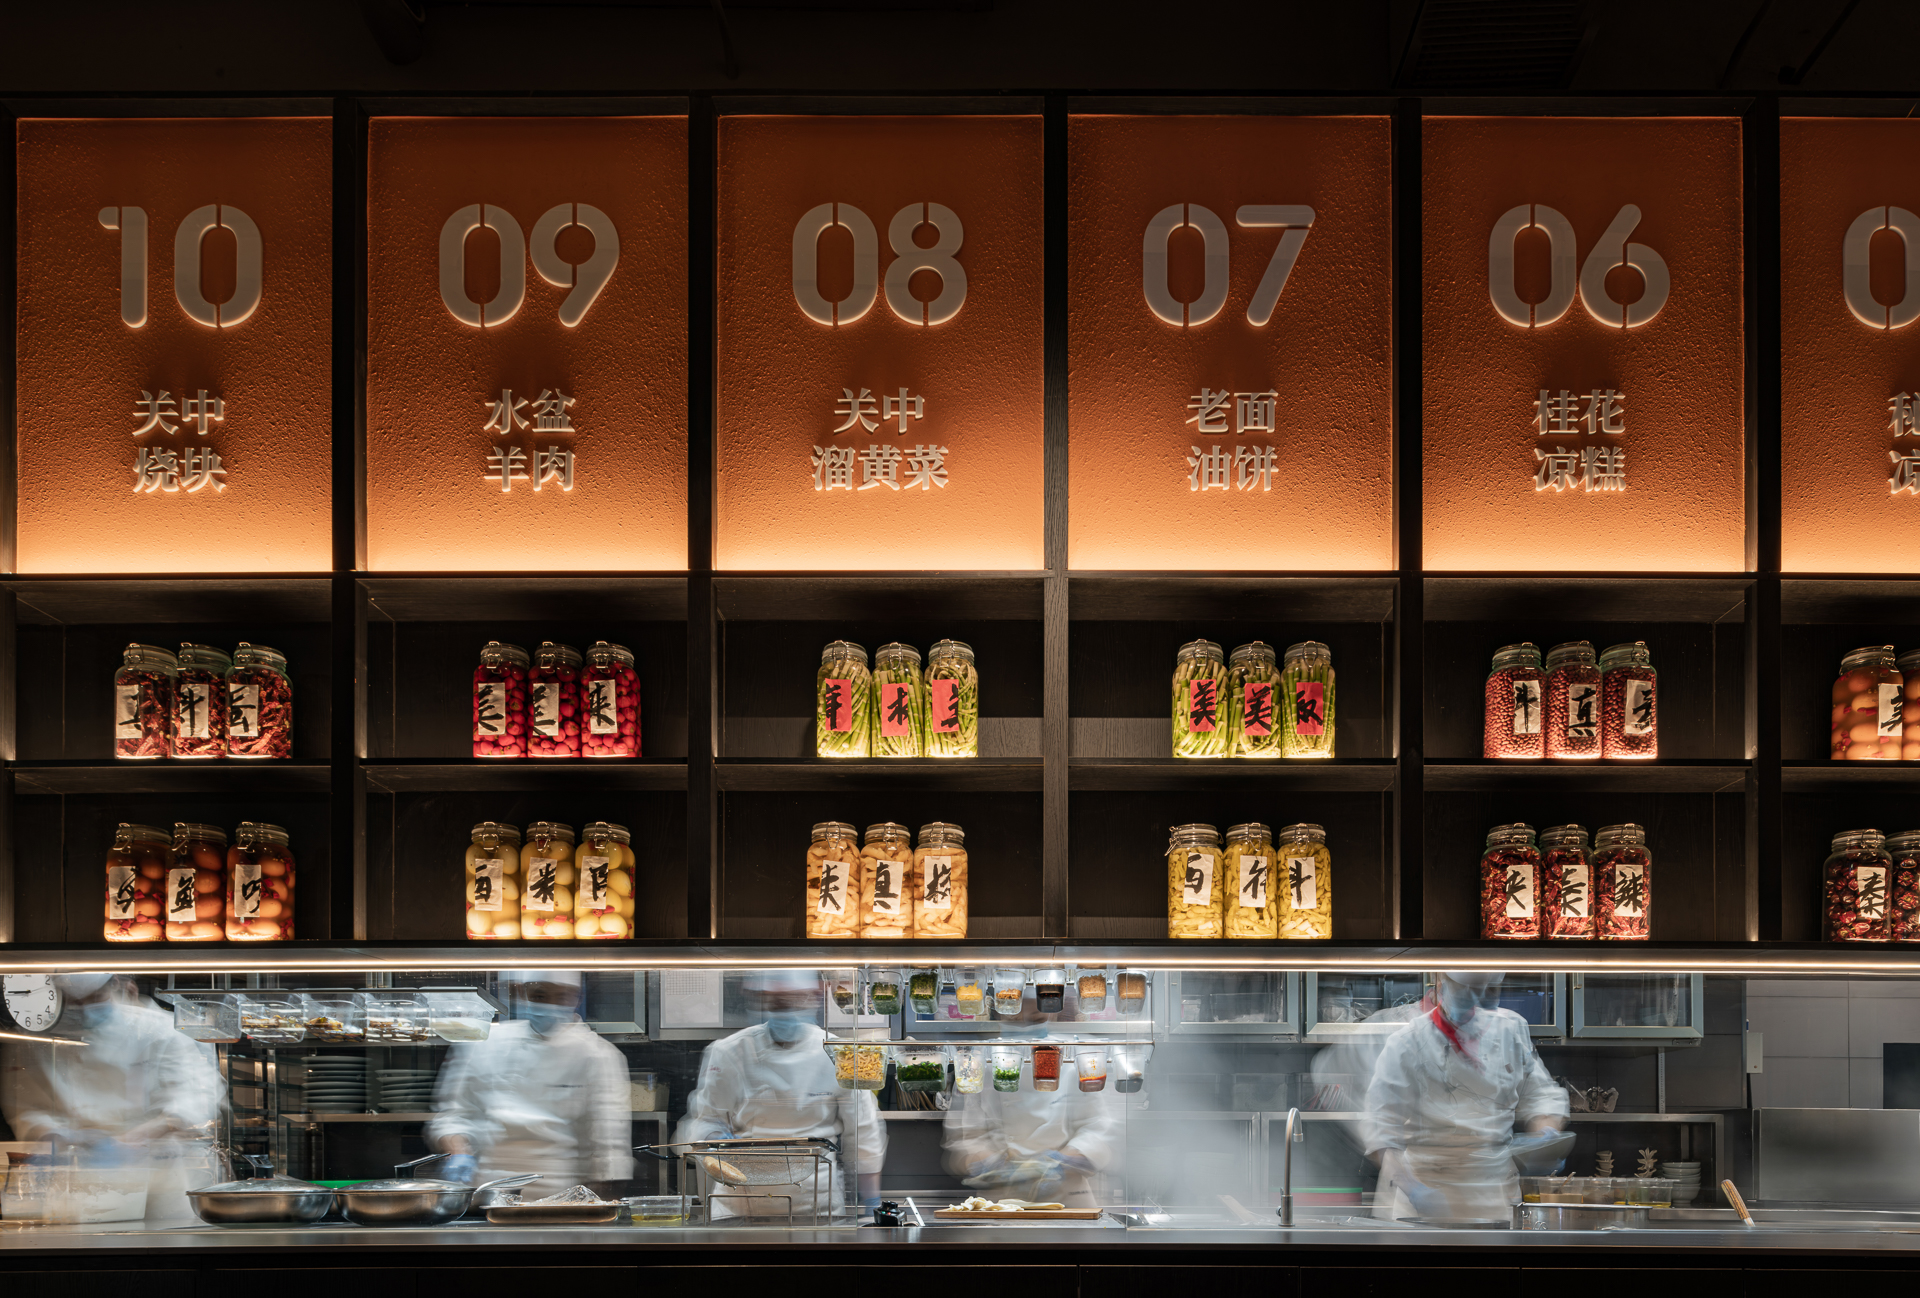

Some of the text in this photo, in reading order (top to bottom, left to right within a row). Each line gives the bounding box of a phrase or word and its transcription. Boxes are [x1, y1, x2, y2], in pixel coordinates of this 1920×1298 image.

[98, 204, 263, 328] 10
[439, 203, 620, 328] 09
[792, 202, 967, 326] 08
[1143, 203, 1316, 327] 07
[1488, 203, 1671, 328] 06
[132, 389, 226, 436] 关中
[483, 388, 576, 435] 水盆
[834, 387, 925, 433] 关中
[1186, 388, 1279, 434] 老面
[1532, 389, 1626, 435] 桂花
[132, 447, 227, 493] 烧块
[484, 446, 576, 492] 羊肉
[811, 444, 949, 491] 溜黄菜
[1187, 445, 1279, 491] 油饼
[1532, 446, 1626, 492] 凉糕
[14, 1010, 20, 1020] 7
[45, 1005, 51, 1014] 4
[48, 990, 54, 1000] 3
[25, 1016, 32, 1028] 6
[36, 1014, 42, 1024] 5
